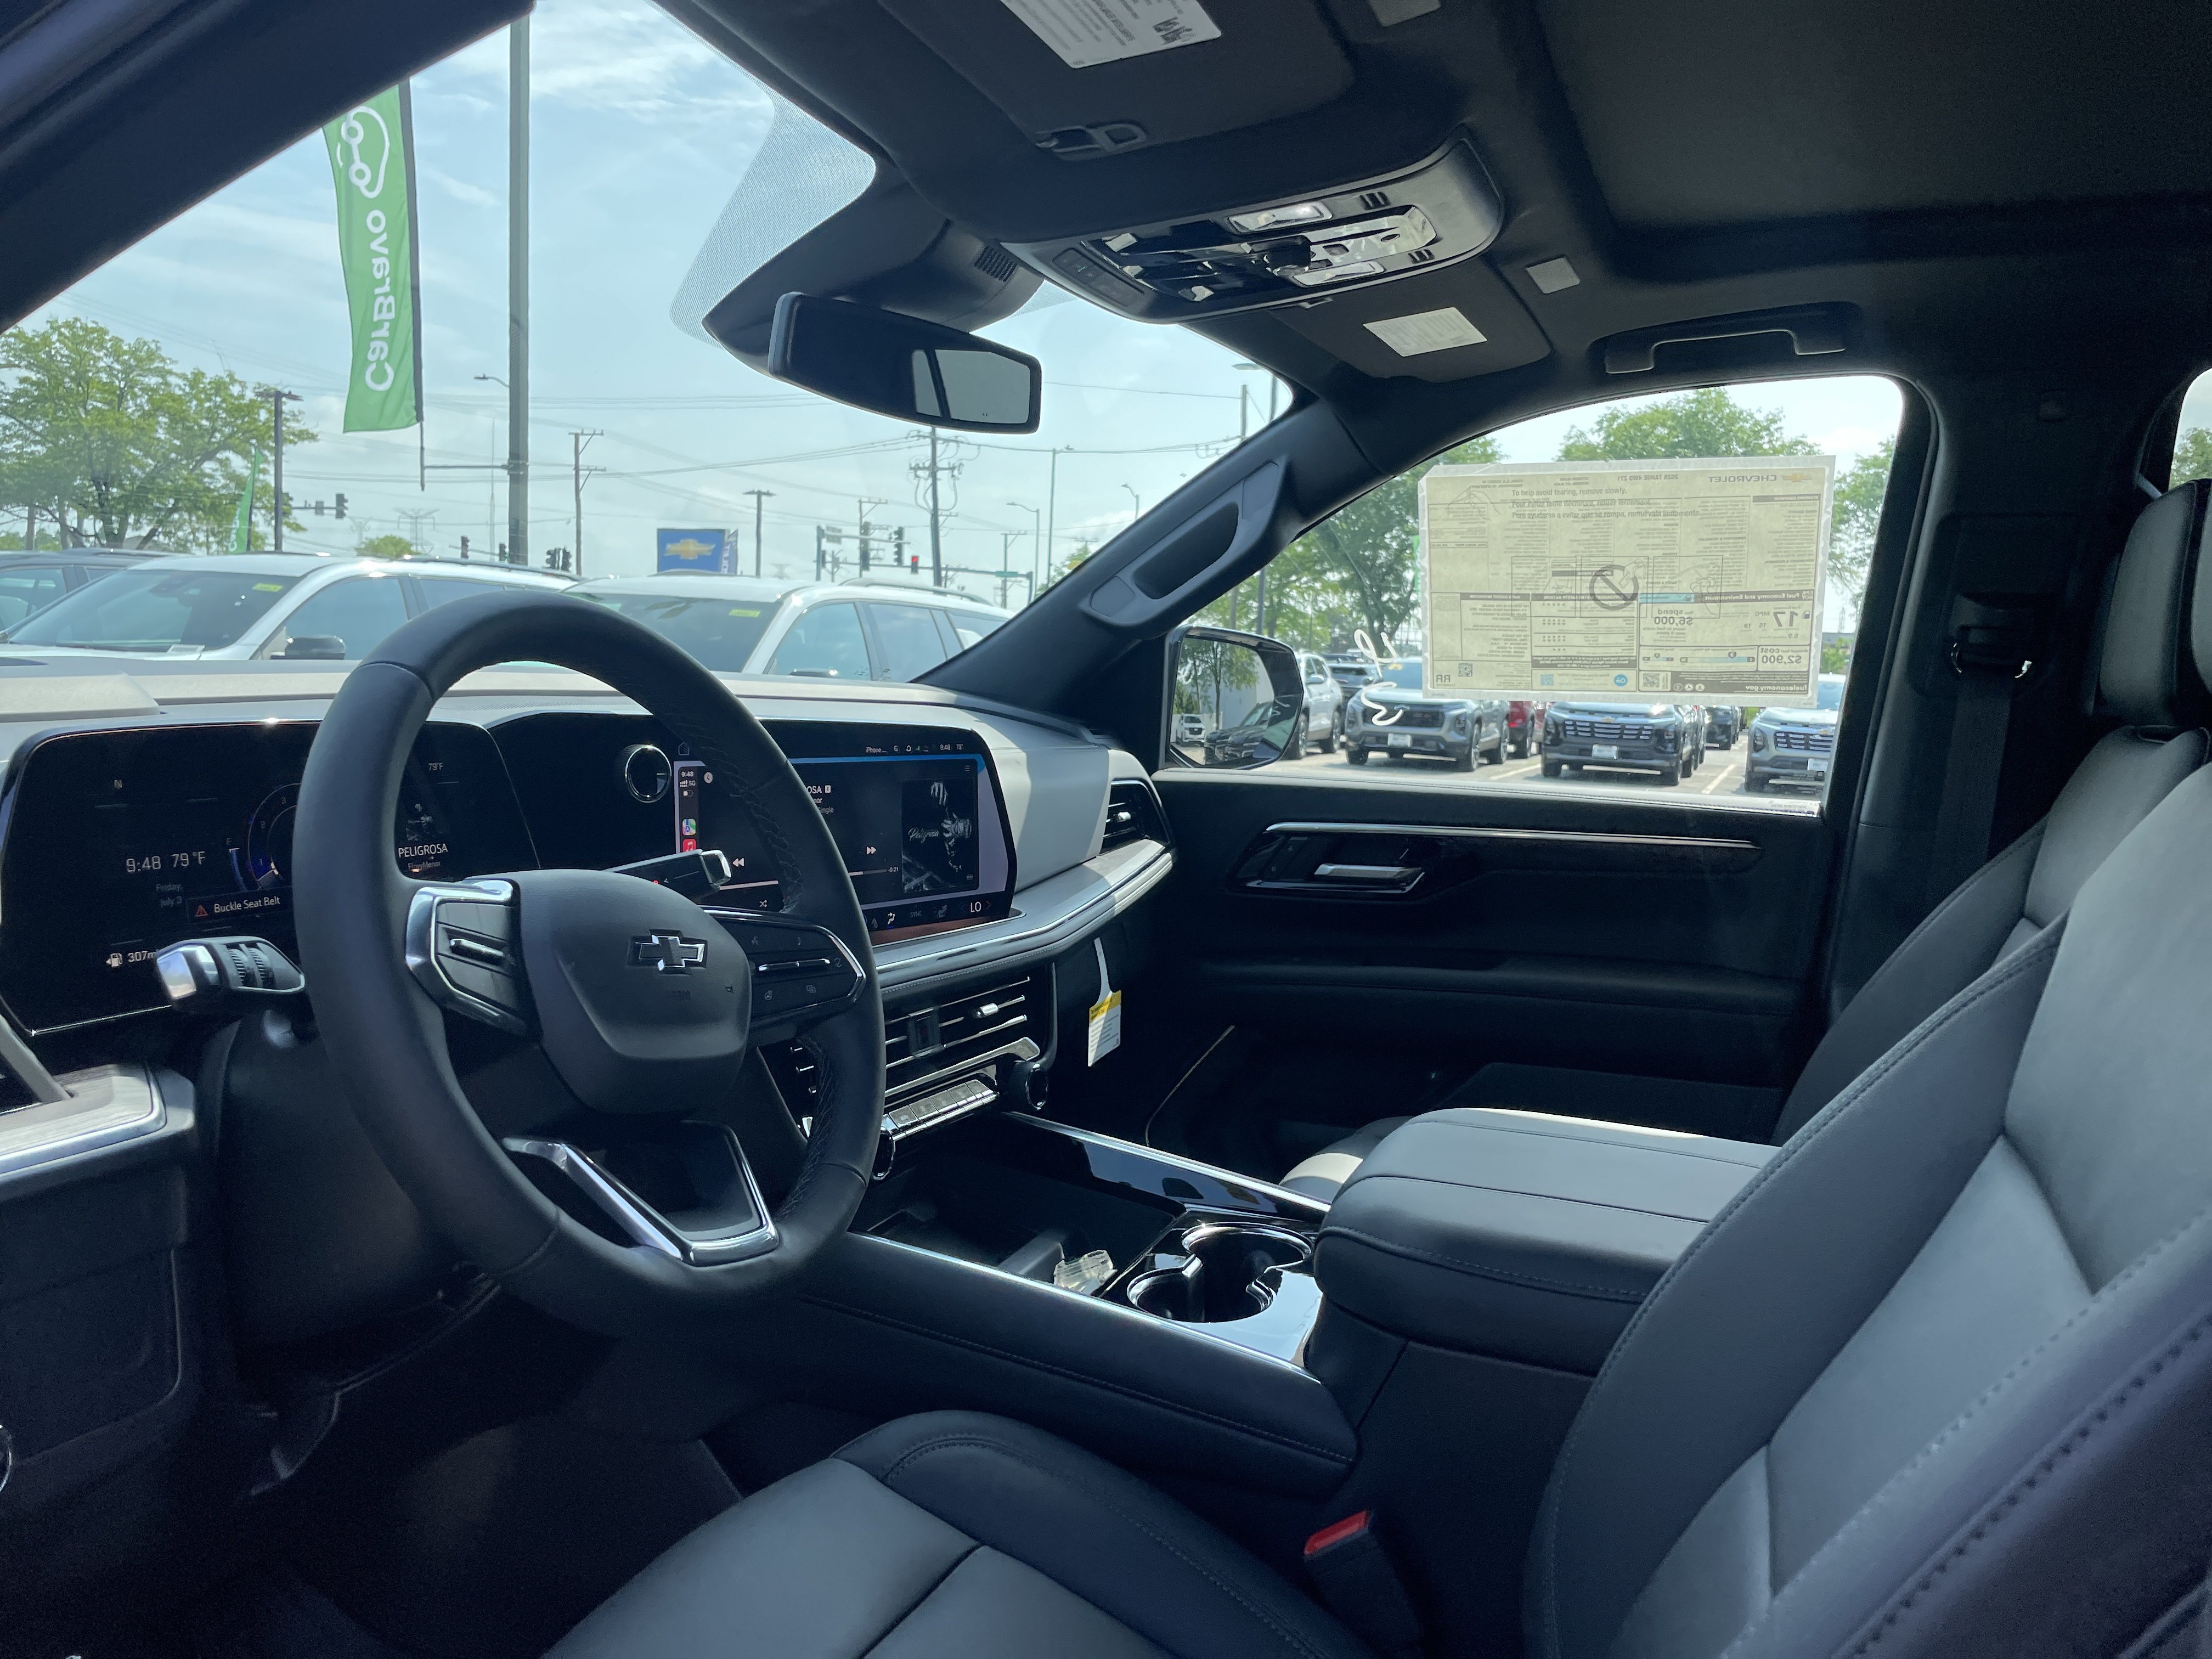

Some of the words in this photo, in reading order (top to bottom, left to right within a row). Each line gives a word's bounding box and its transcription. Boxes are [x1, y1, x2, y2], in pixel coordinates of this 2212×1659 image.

[114, 779, 122, 788] N
[398, 843, 448, 857] PELIGROSA
[126, 856, 161, 873] 9:48
[214, 901, 241, 913] Buckle
[244, 899, 262, 909] Seat
[264, 895, 280, 906] Belt
[970, 901, 981, 913] LO
[910, 910, 922, 918] SYNC
[128, 951, 156, 962] 307m
